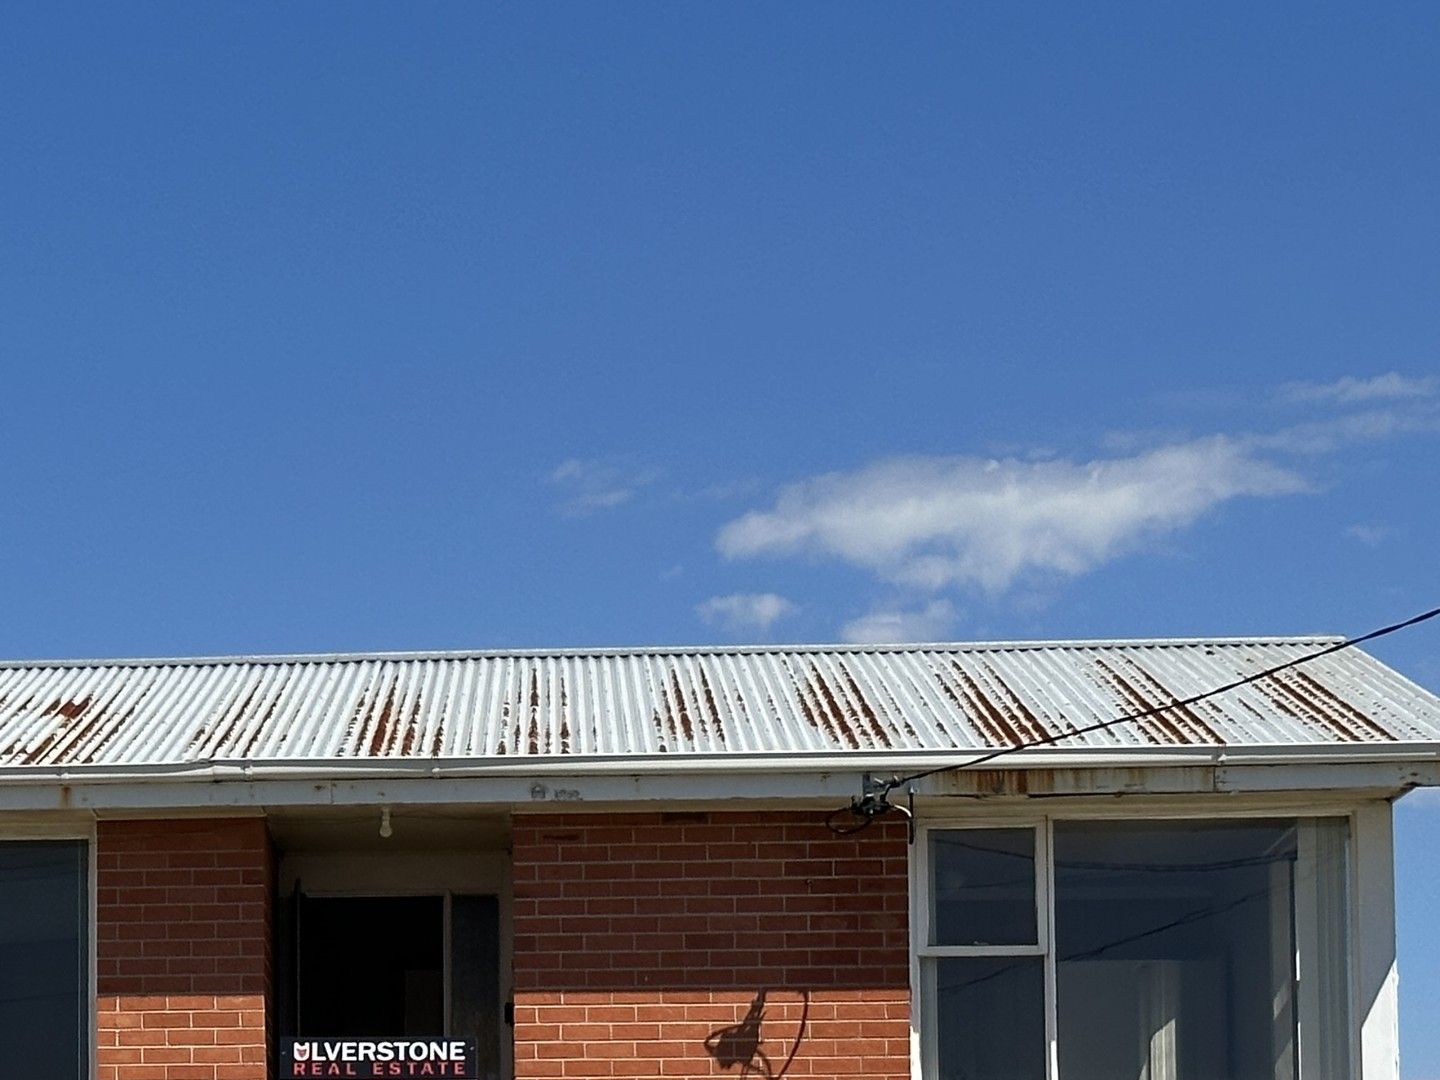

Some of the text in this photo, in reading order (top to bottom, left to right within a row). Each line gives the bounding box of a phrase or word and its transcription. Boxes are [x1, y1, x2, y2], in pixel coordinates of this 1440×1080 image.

[294, 1042, 466, 1061] ULVERSTONE
[294, 1062, 466, 1075] REAL ESTATE
